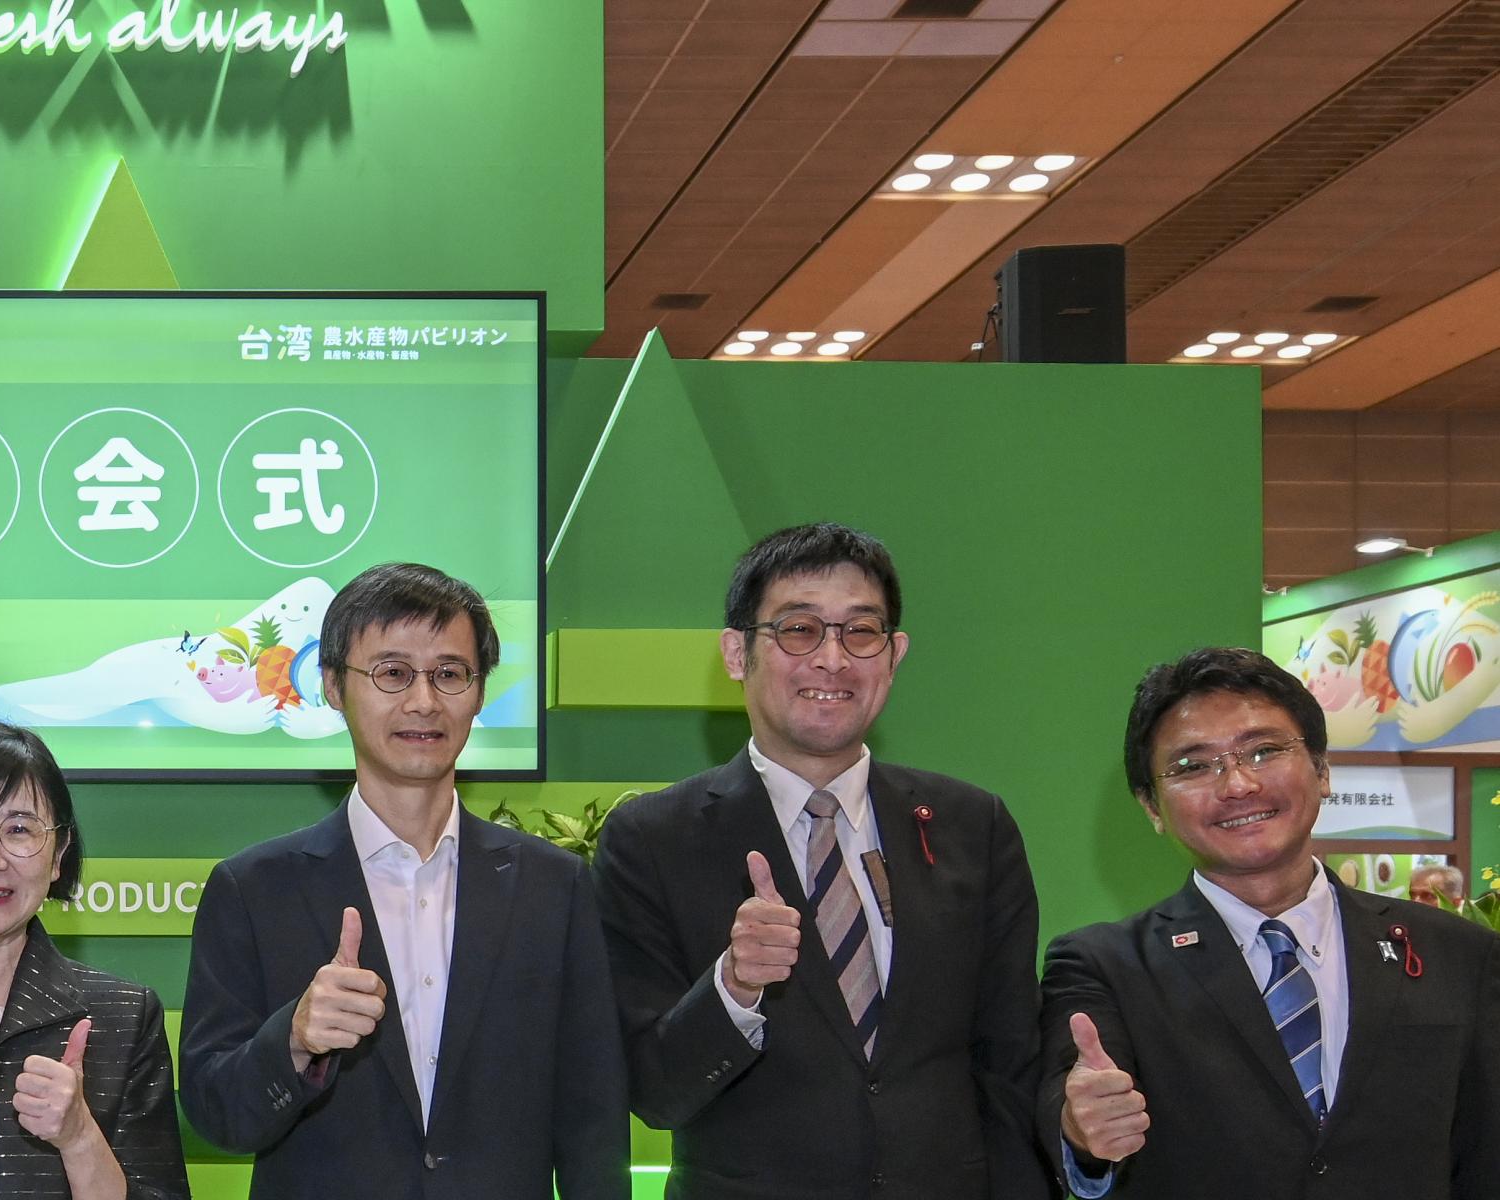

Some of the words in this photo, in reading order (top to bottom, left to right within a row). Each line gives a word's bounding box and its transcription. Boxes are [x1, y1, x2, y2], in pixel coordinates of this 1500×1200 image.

[107, 0, 349, 78] always
[237, 324, 313, 362] 台湾
[323, 326, 508, 347] 農水産物パビリオン
[1321, 792, 1395, 806] 発有限会社
[38, 880, 206, 914] RODUC
